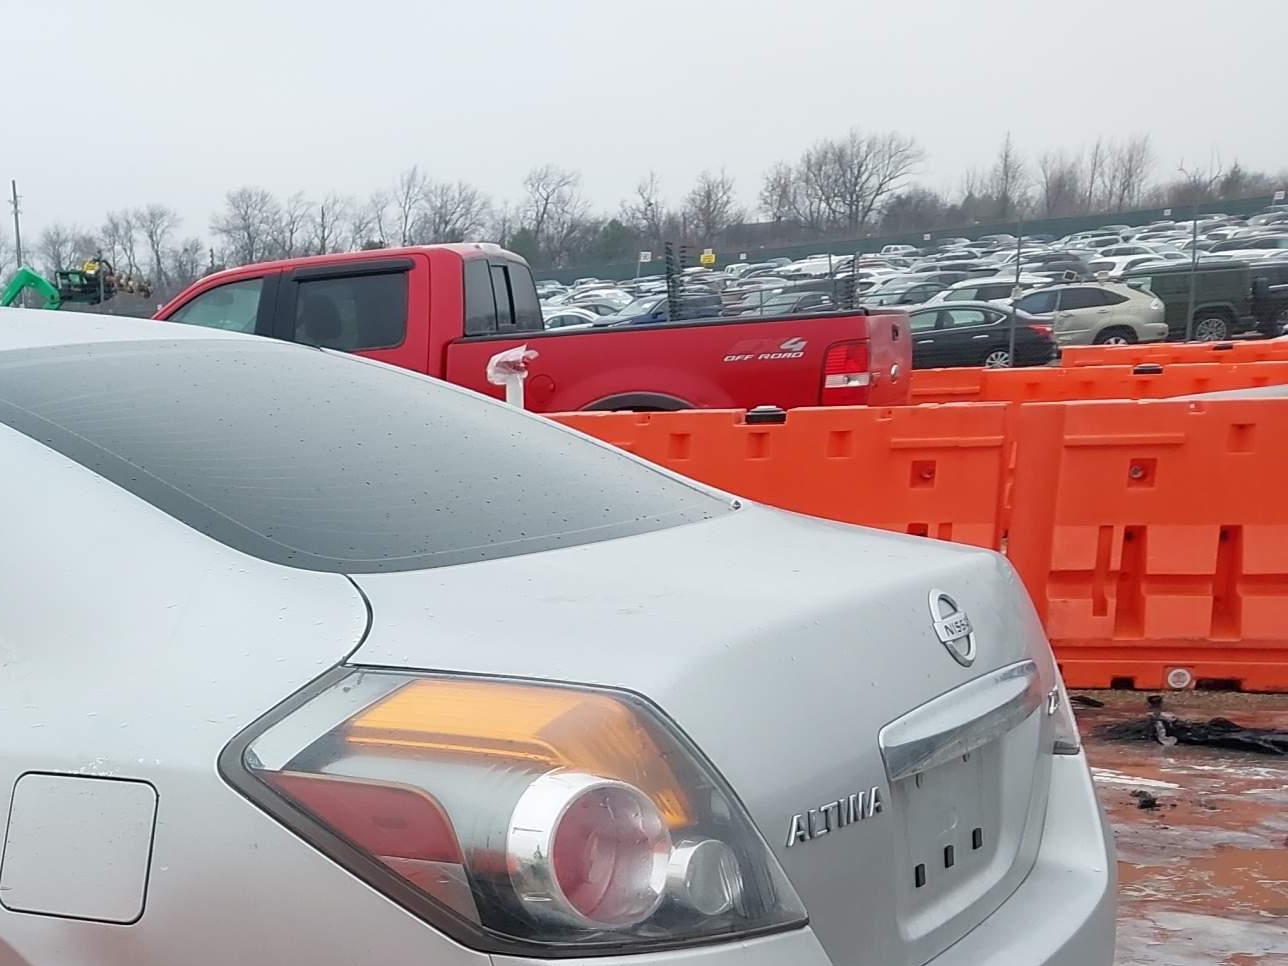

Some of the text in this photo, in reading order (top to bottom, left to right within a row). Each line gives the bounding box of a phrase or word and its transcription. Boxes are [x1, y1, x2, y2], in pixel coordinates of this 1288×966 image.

[723, 352, 804, 362] OFF ROAD
[786, 786, 883, 847] ALTIMA
